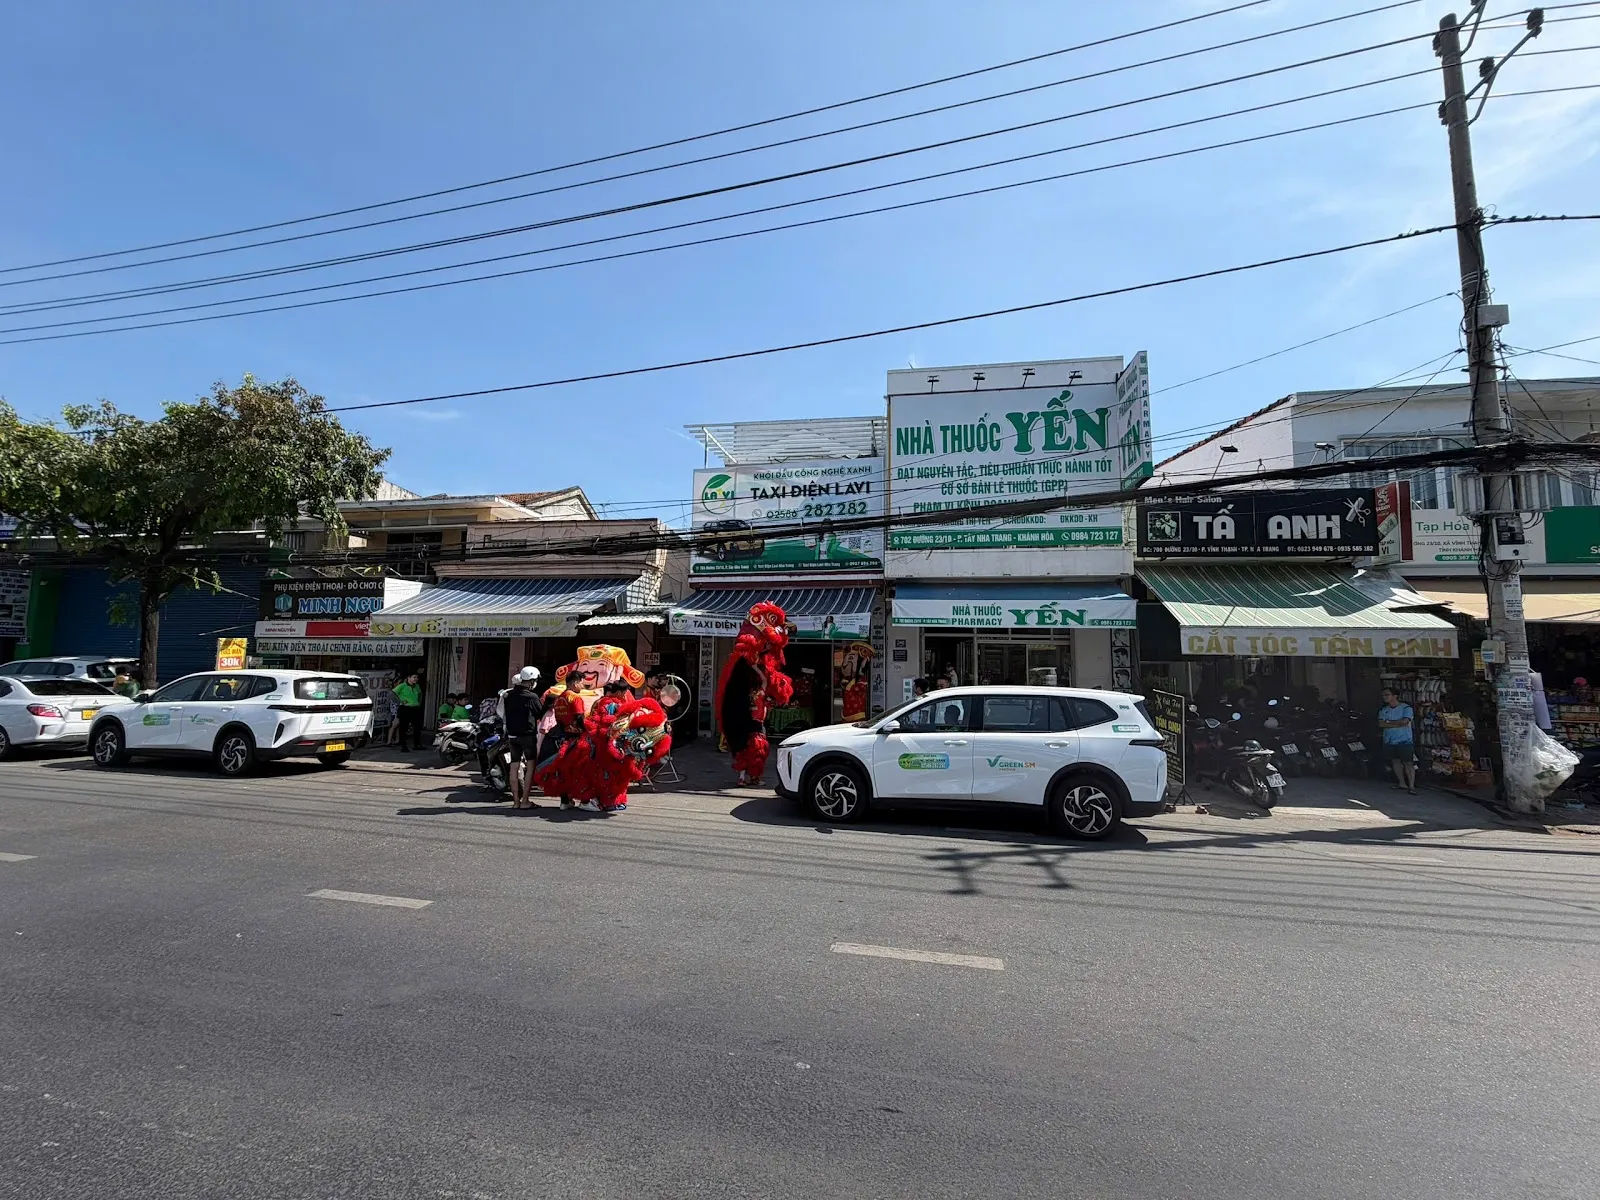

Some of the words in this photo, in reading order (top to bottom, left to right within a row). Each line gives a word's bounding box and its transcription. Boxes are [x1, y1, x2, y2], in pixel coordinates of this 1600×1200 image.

[896, 420, 934, 456] NHÀ
[940, 412, 1001, 454] THUỐC
[1005, 390, 1111, 455] YẾN
[795, 468, 819, 478] CÔNG
[847, 465, 871, 475] XANH
[1066, 458, 1092, 474] HÀNH
[1095, 455, 1112, 472] TỐT
[751, 484, 786, 500] TAXI
[791, 480, 829, 501] ĐIỆN
[835, 481, 871, 496] LAVI
[804, 503, 834, 518] 282
[836, 501, 867, 516] 282
[1267, 514, 1341, 540] ANH
[1416, 521, 1439, 534] Tạp
[1444, 518, 1470, 531] Hóa
[977, 533, 990, 543] NHA
[991, 532, 1012, 543] TRANG
[1018, 530, 1039, 542] KHÁNH
[1041, 530, 1055, 542] HÒA
[1071, 531, 1088, 542] 0984
[1090, 531, 1104, 541] 723
[1106, 531, 1119, 541] 127
[289, 581, 304, 593] KIỆN
[305, 581, 321, 593] ĐIỆN
[298, 597, 342, 614] MINH
[952, 604, 970, 616] NHÀ
[974, 602, 1002, 616] THUỐC
[1008, 602, 1087, 626] YẾN
[354, 622, 369, 631] viet
[371, 616, 443, 636] QUẾ
[694, 620, 713, 629] TAXI
[715, 619, 737, 632] ĐIỆN
[952, 618, 1002, 627] PHARMACY
[1187, 629, 1238, 655] CẮT
[1246, 635, 1298, 655] TÓC
[1309, 630, 1374, 656] TẤN
[1384, 636, 1452, 657] ANH
